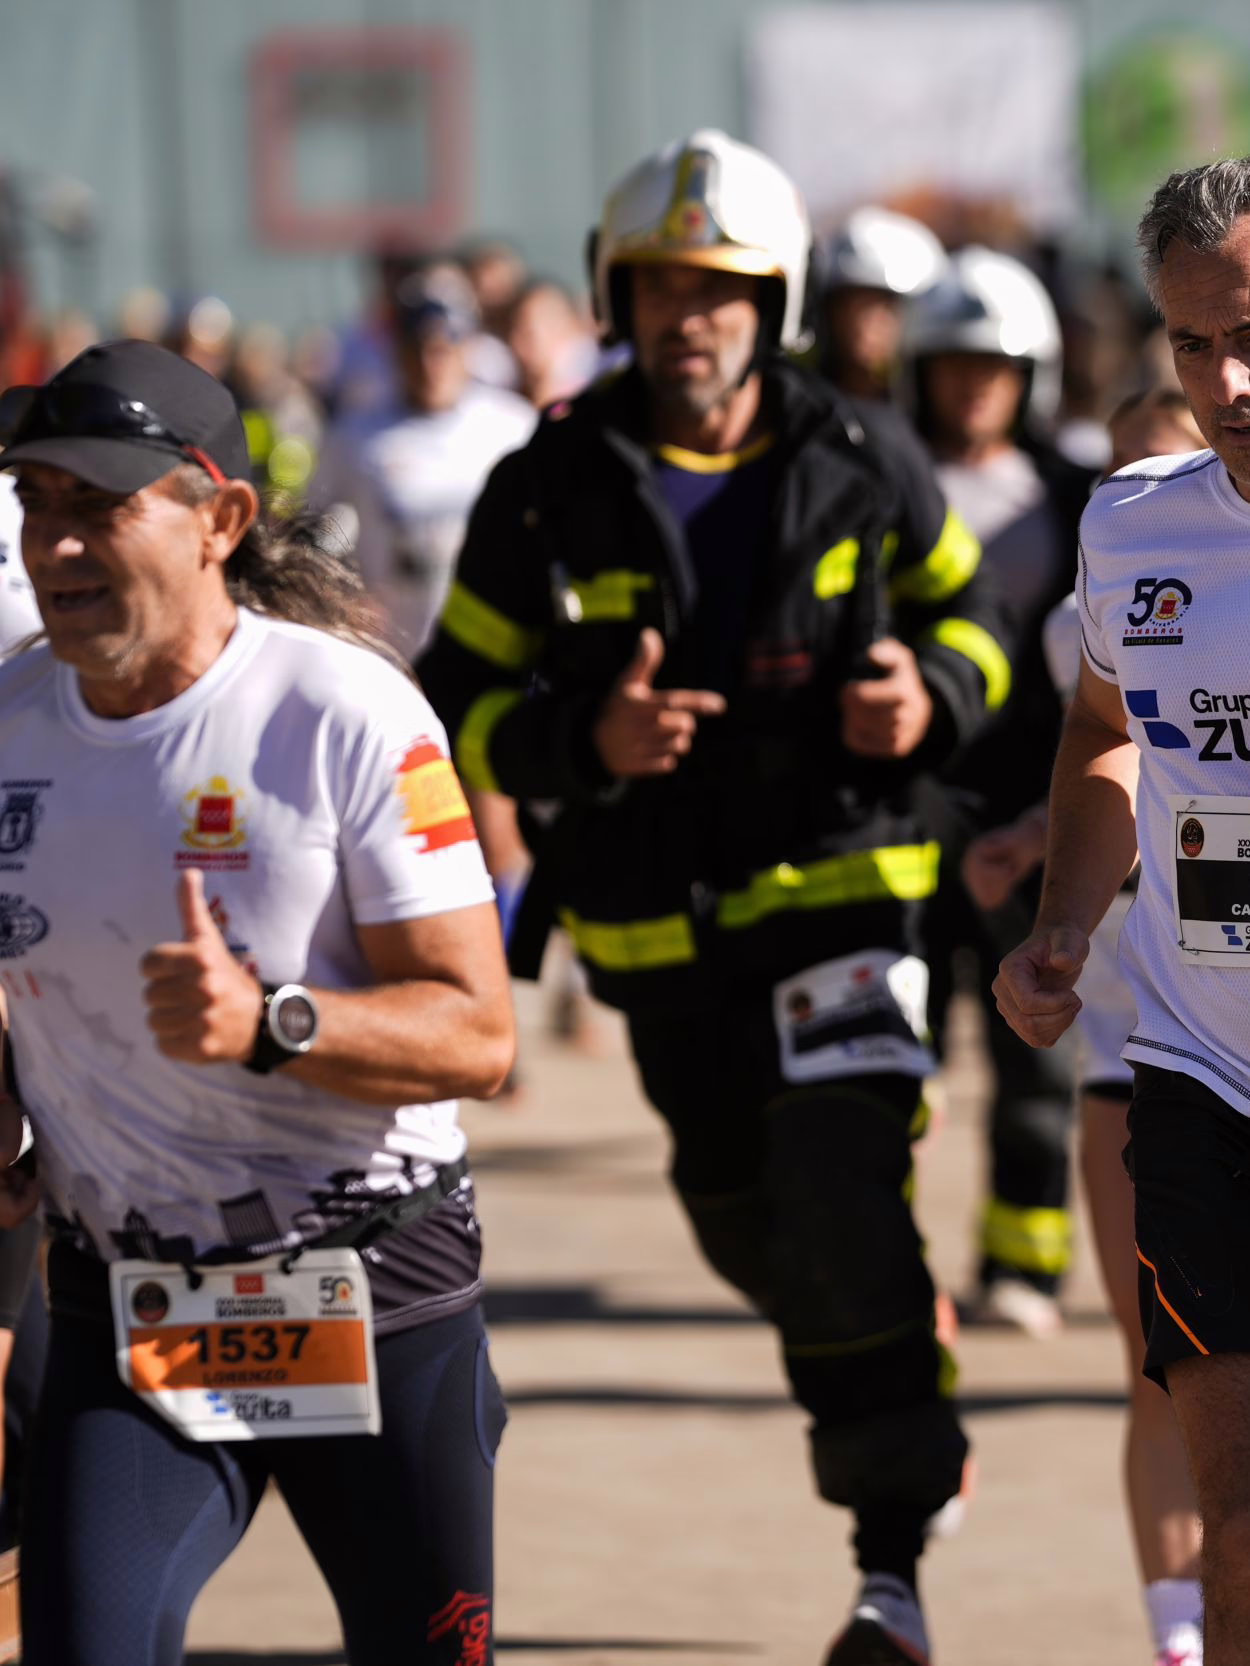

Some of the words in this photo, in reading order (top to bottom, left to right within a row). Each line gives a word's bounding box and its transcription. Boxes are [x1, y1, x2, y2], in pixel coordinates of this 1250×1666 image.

[1127, 578, 1193, 627] 50
[216, 1305, 286, 1318] BOMBEROS
[189, 1324, 311, 1364] 1537
[202, 1369, 288, 1384] LORENZO
